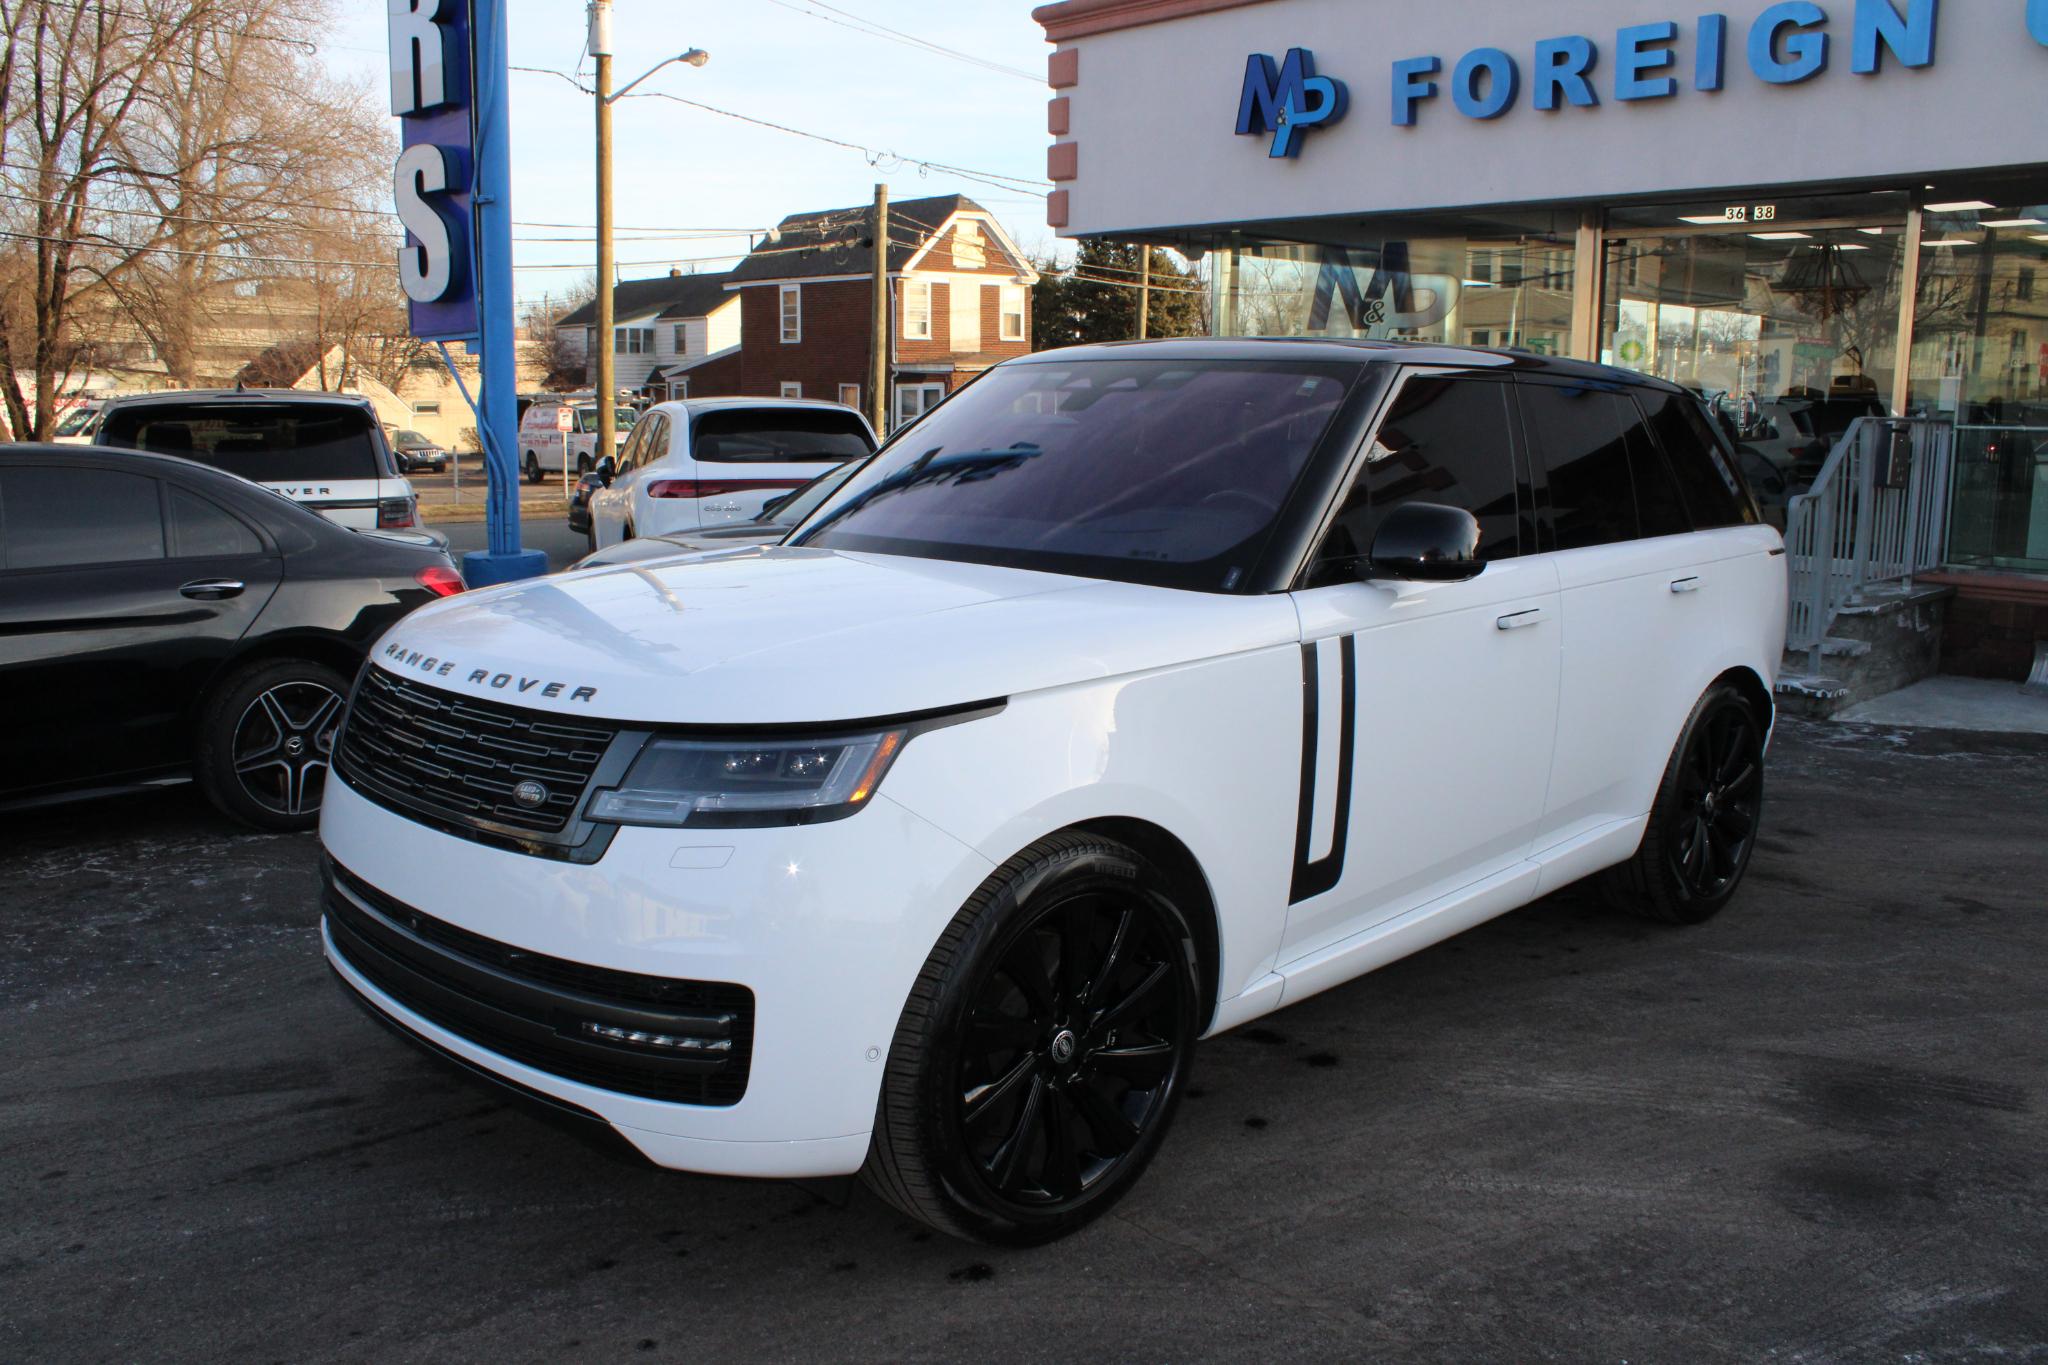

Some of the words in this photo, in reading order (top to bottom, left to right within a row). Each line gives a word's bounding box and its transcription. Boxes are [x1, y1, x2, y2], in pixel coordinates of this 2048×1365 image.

[1391, 0, 1935, 126] FOREIGN
[385, 643, 456, 676] RANGE
[467, 668, 598, 702] ROVER
